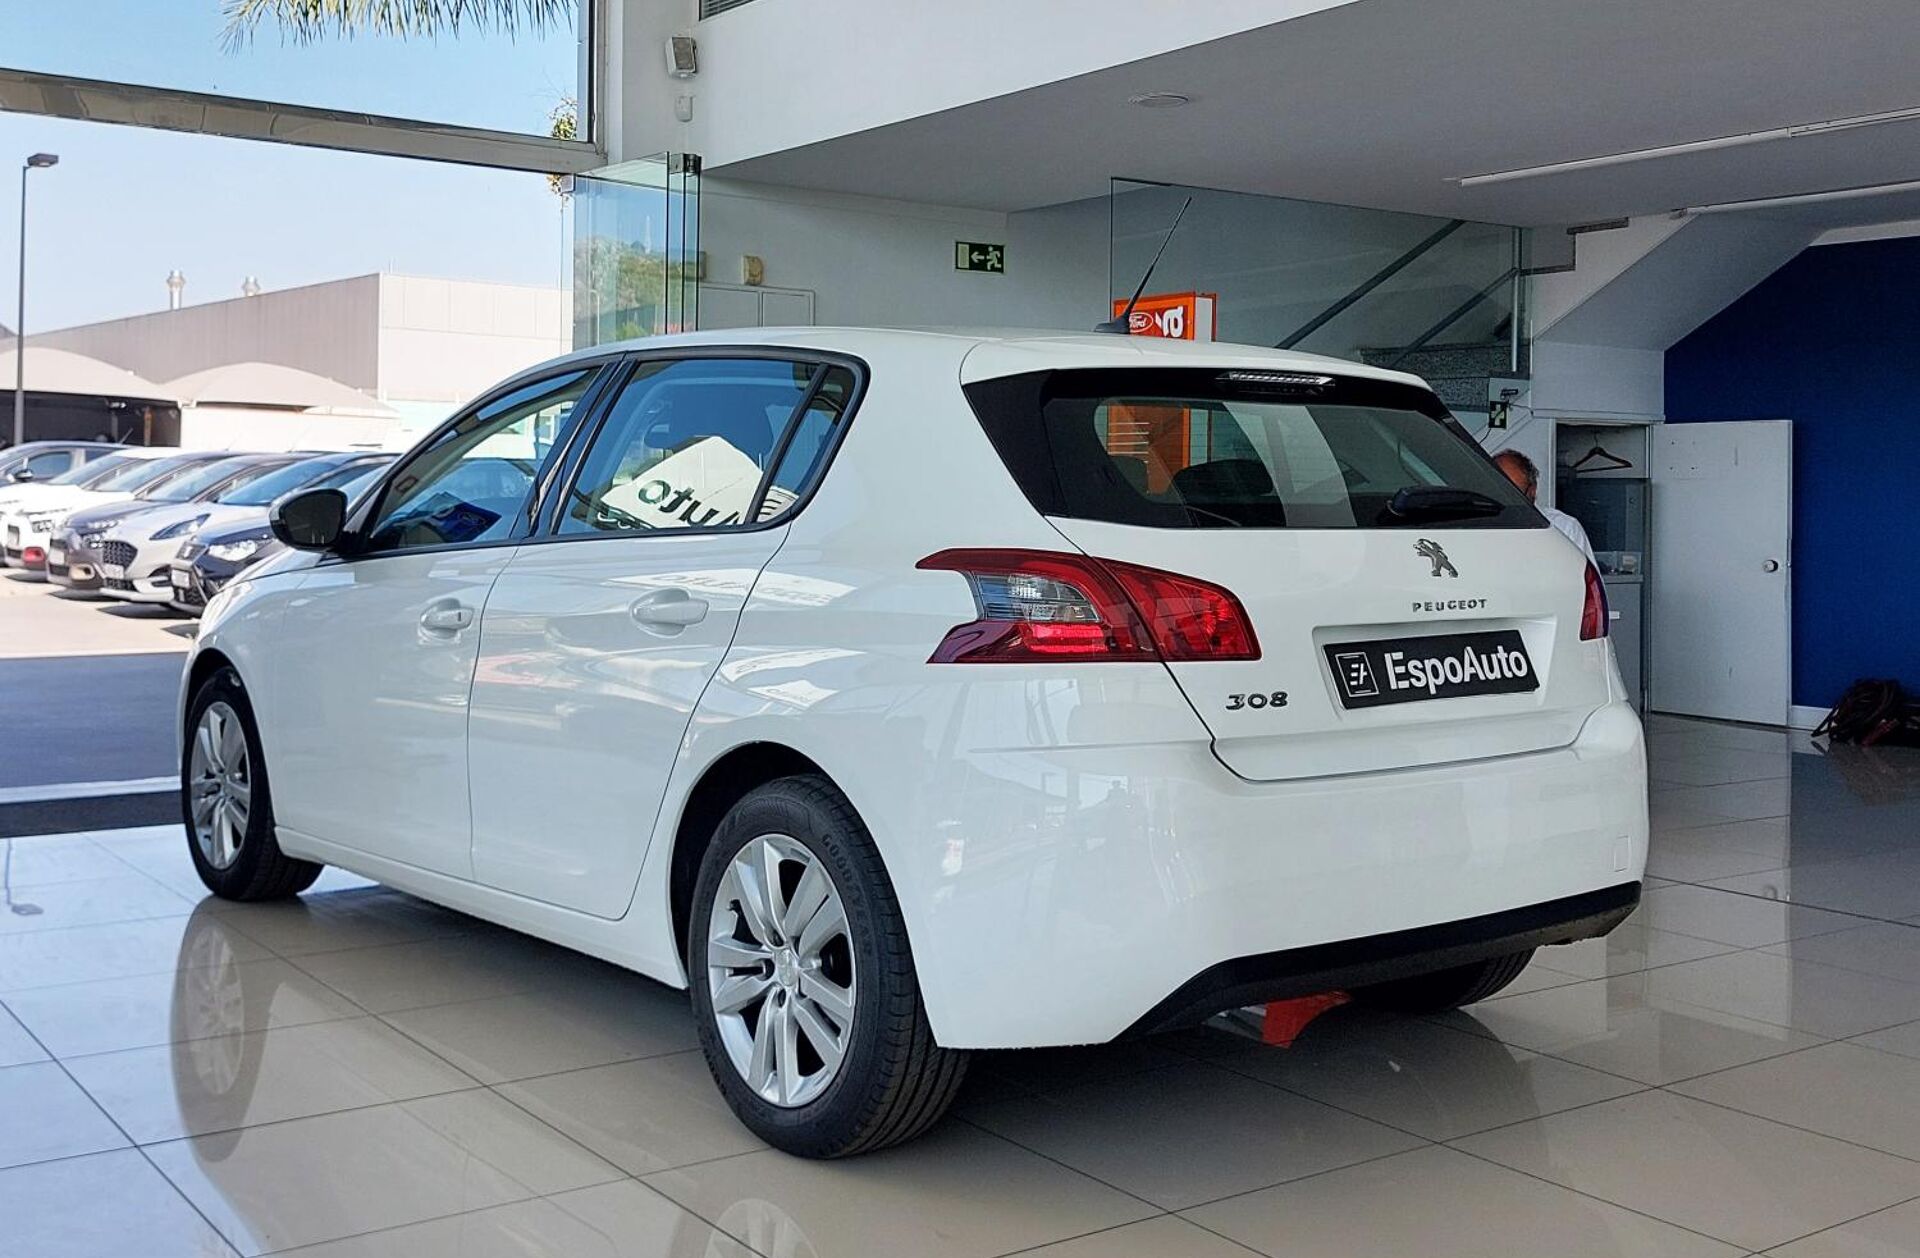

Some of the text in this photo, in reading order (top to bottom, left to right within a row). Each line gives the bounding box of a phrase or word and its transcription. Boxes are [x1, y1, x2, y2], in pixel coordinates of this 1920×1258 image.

[1412, 598, 1487, 613] PEUGEOT
[1384, 645, 1528, 695] EspoAuto
[1225, 691, 1288, 710] 308
